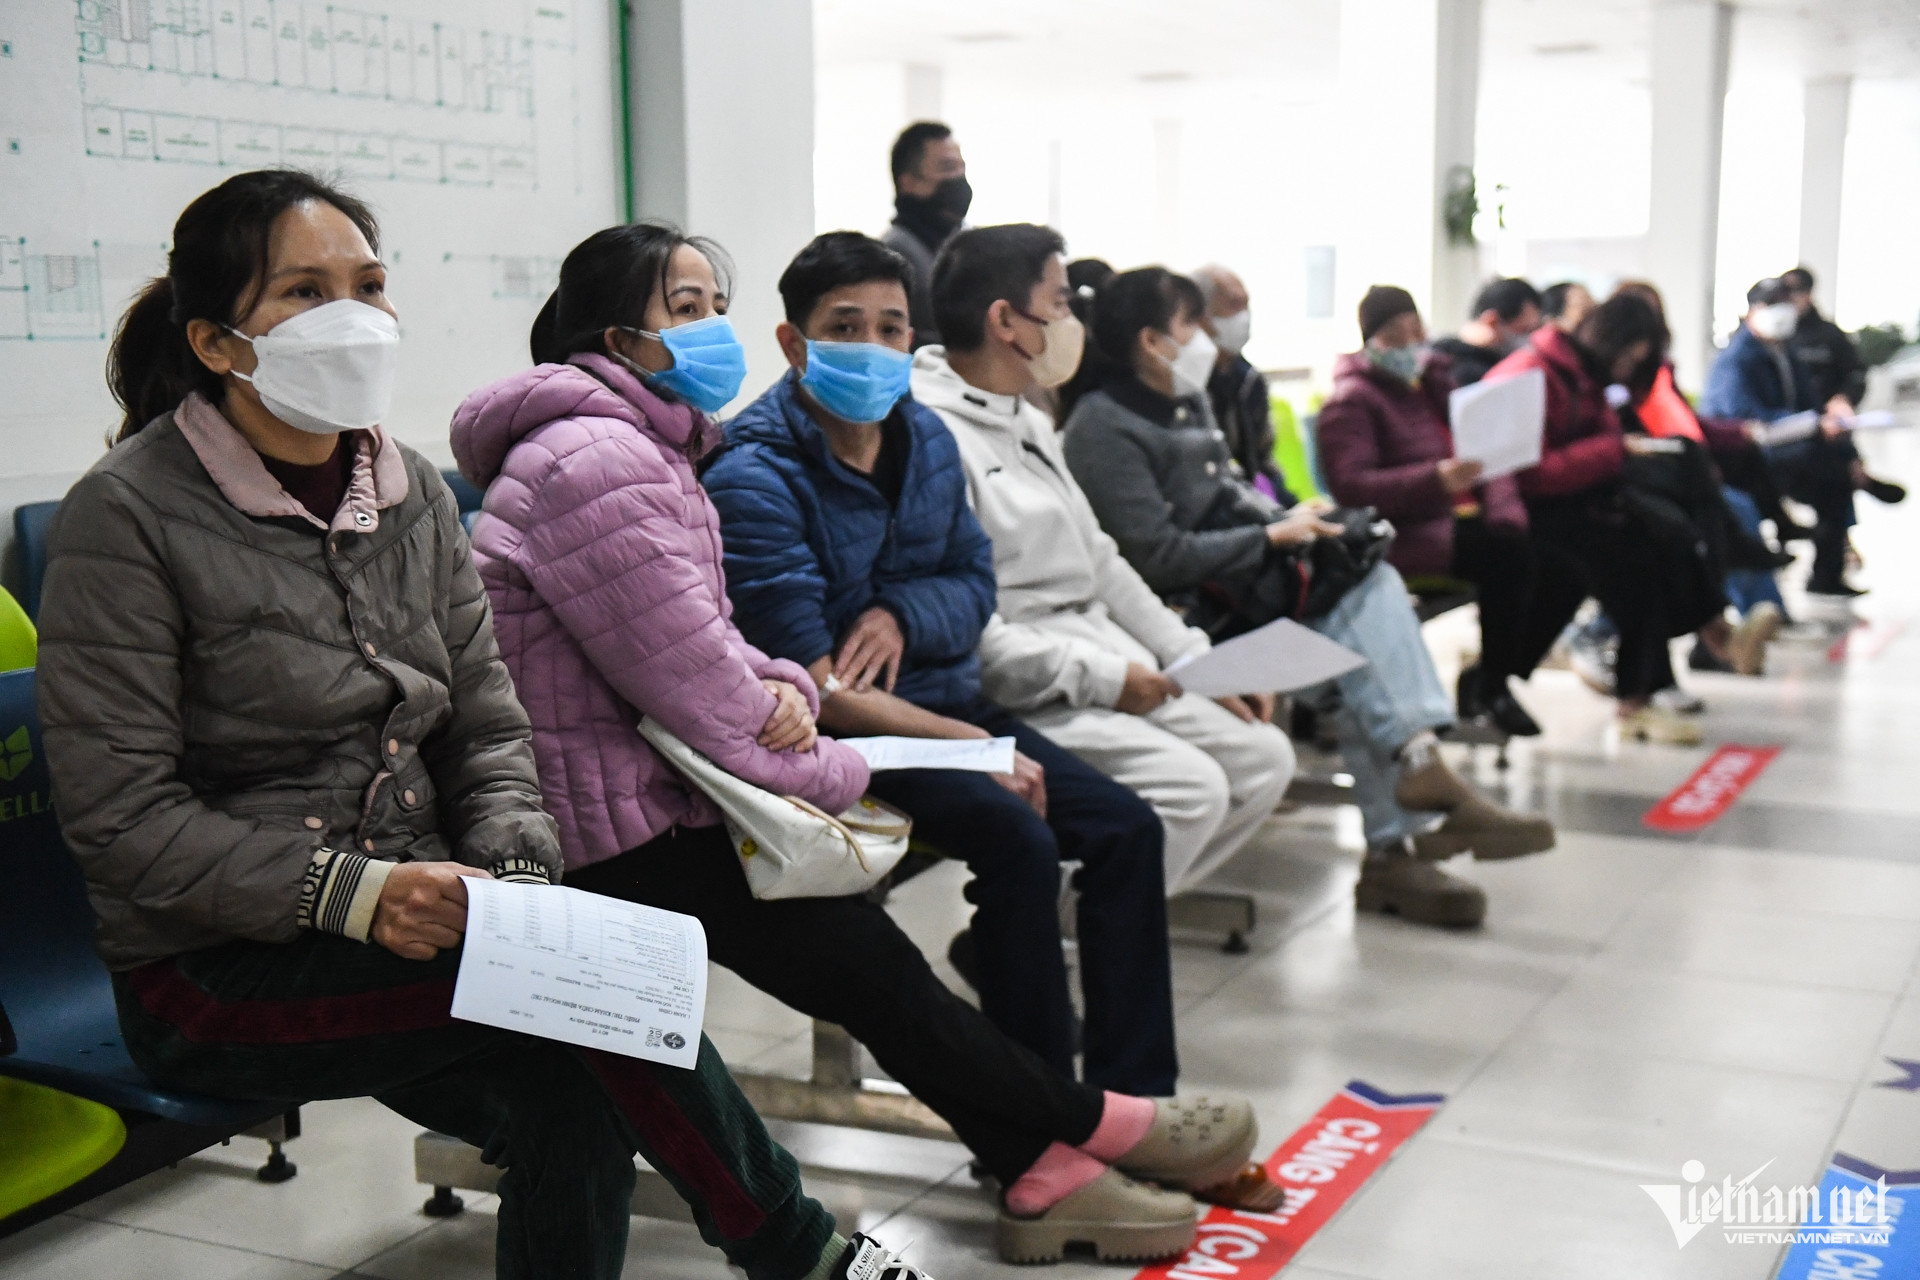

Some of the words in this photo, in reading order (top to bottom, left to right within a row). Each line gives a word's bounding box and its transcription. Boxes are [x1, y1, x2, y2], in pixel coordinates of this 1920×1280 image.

[0, 791, 54, 821] ELL
[297, 861, 325, 920] DIOR
[1166, 1223, 1269, 1280] (CA
